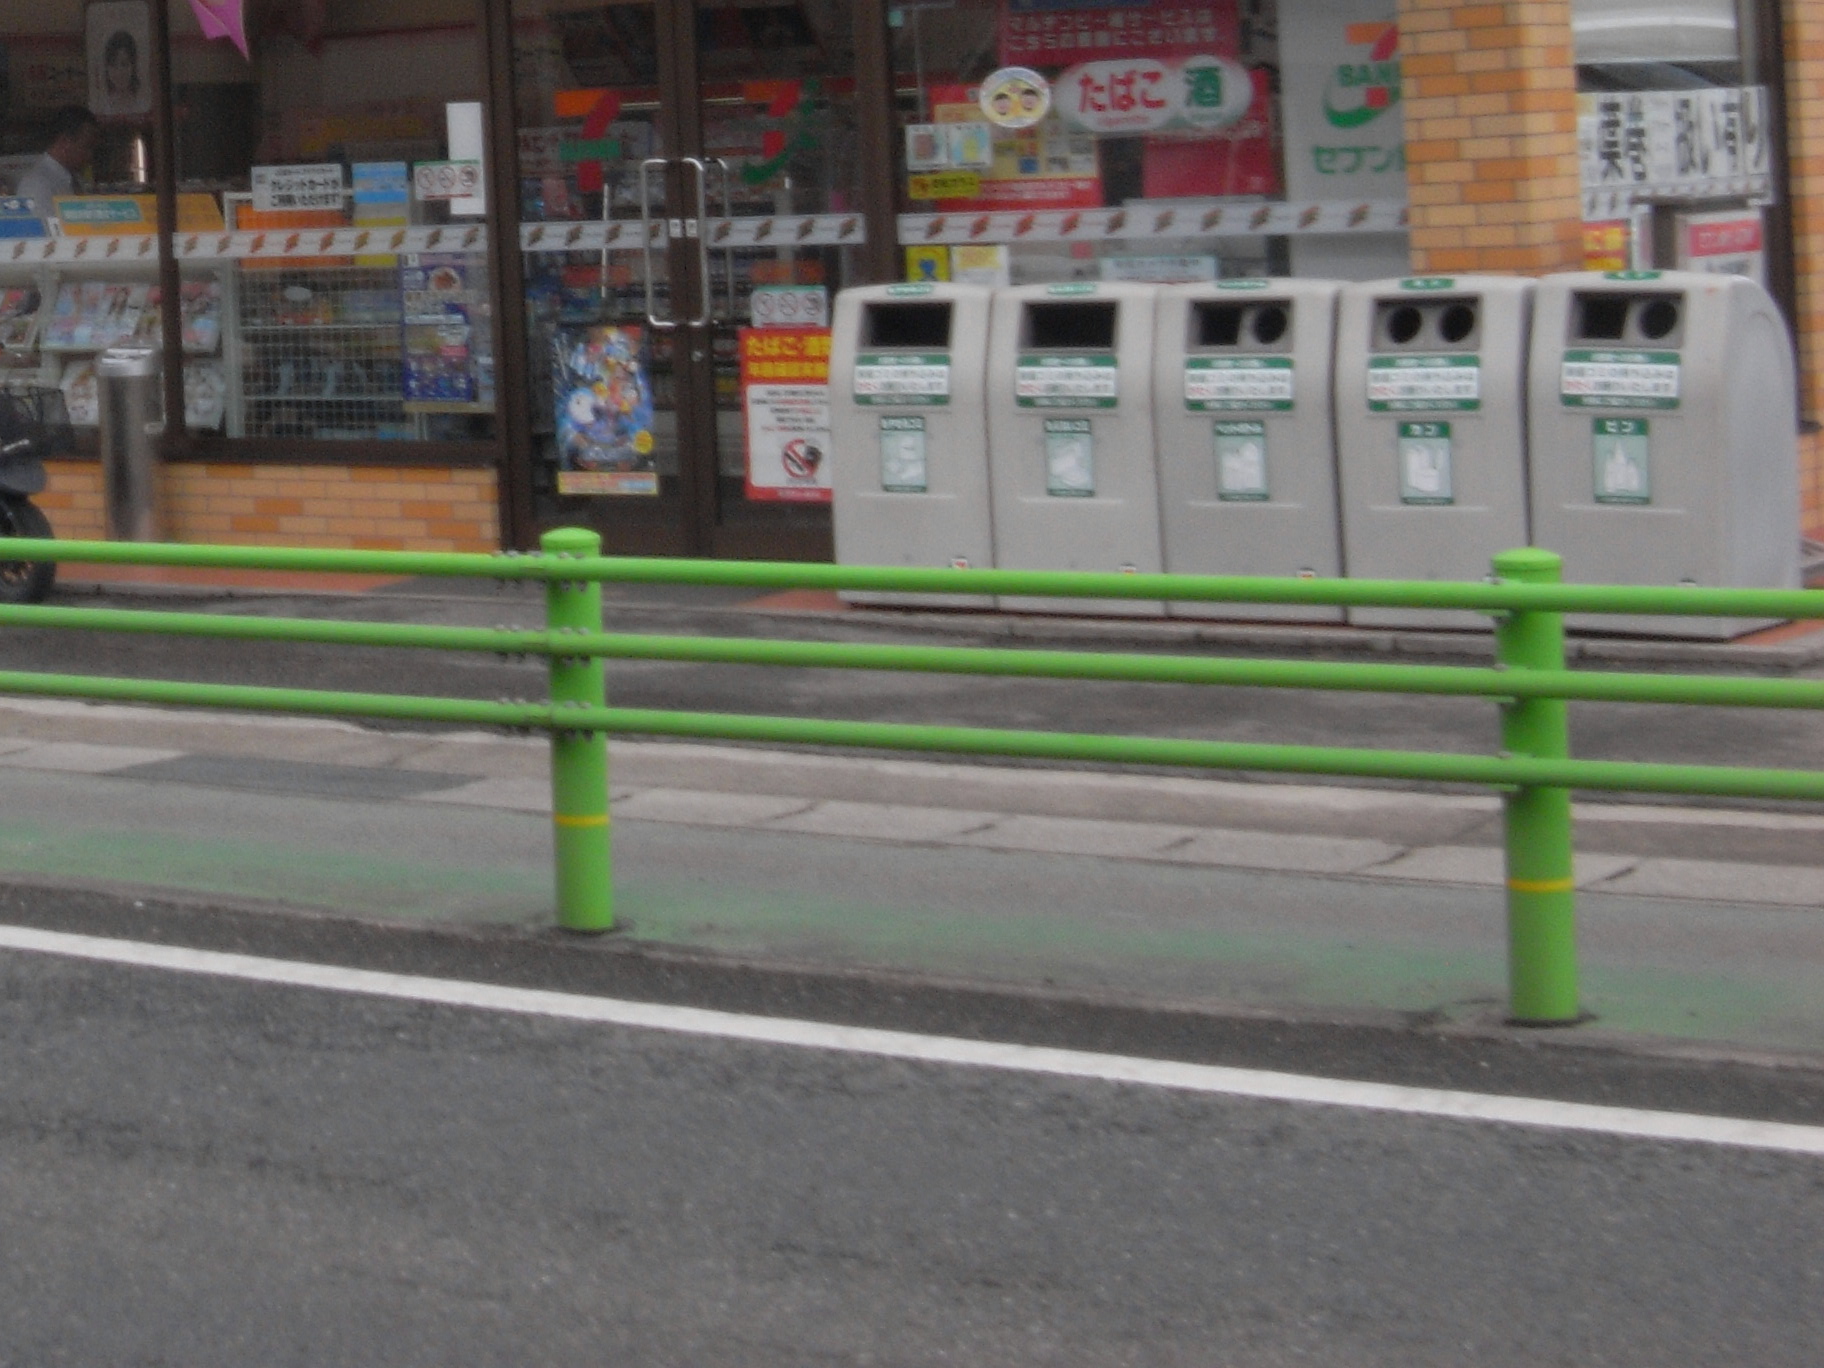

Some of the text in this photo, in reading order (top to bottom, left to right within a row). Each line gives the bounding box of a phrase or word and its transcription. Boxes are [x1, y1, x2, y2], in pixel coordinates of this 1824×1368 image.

[1078, 65, 1221, 113] たばこ 酒
